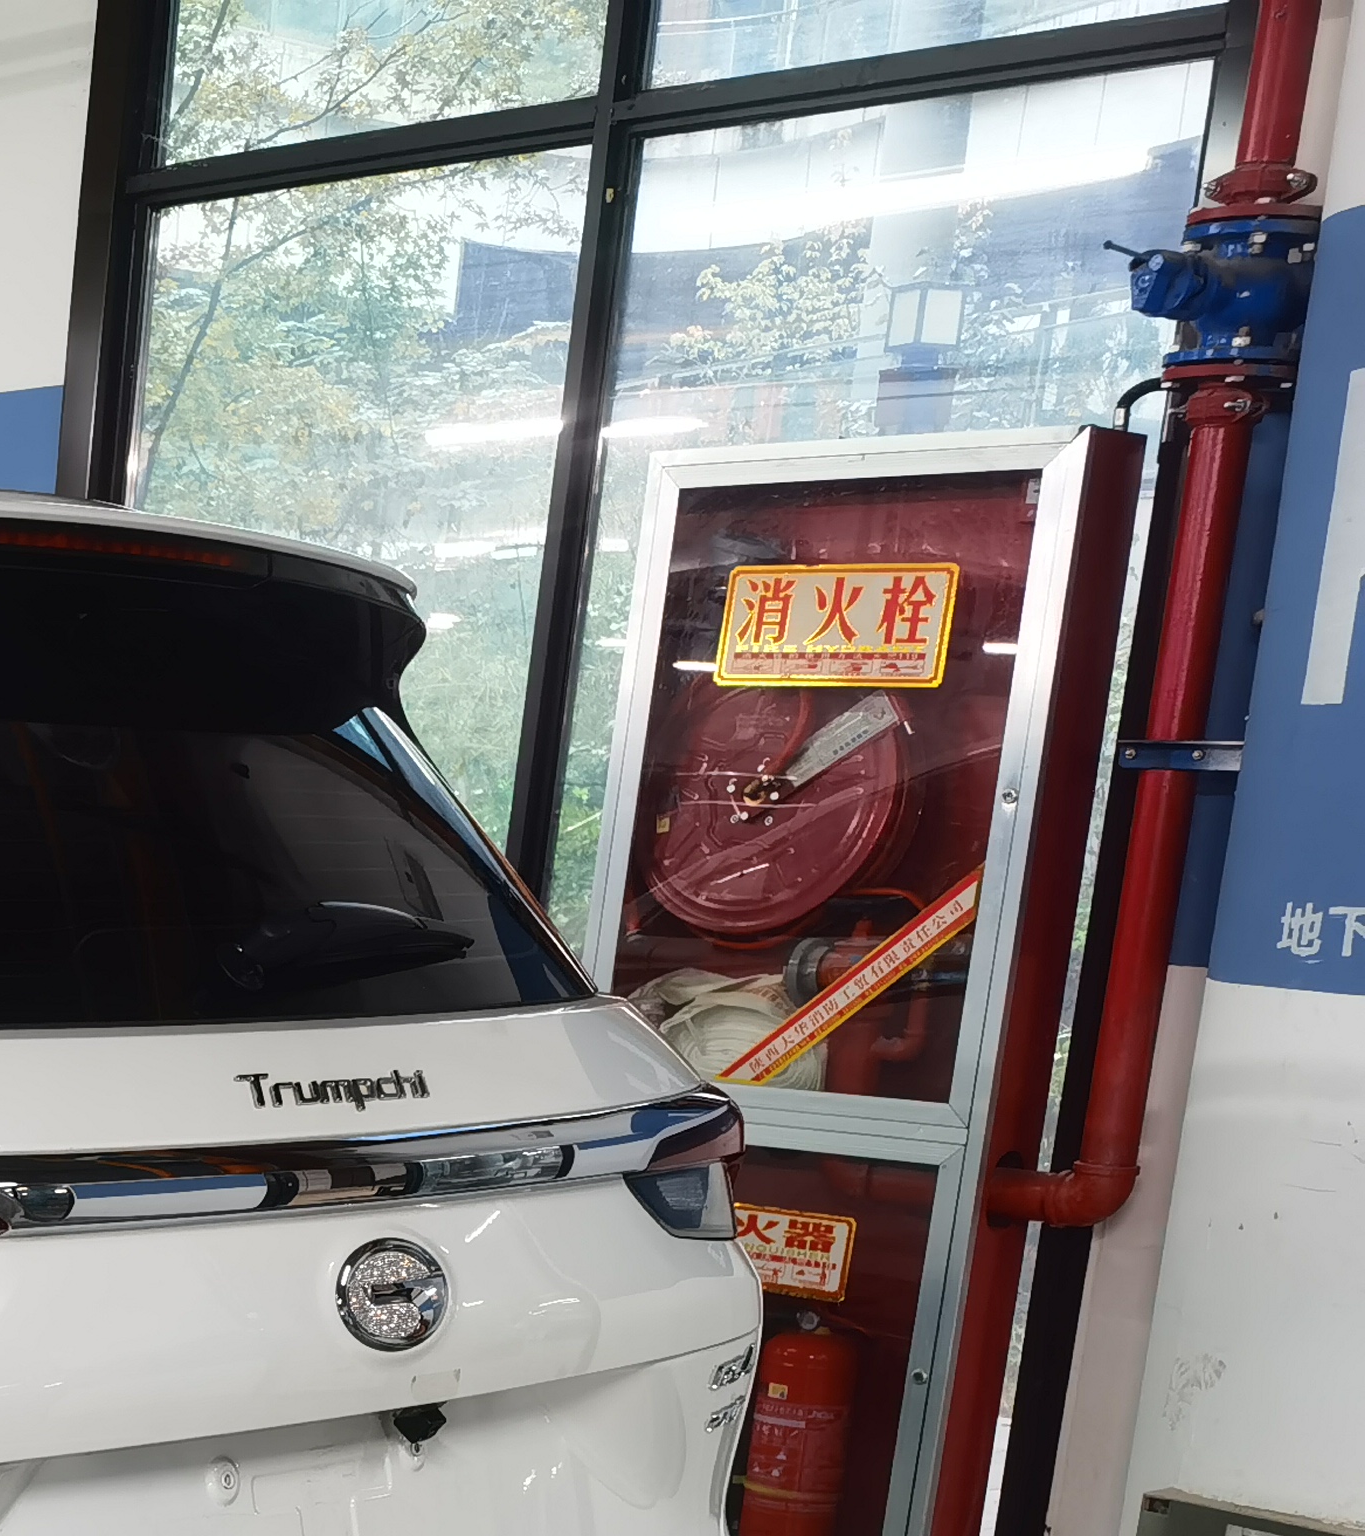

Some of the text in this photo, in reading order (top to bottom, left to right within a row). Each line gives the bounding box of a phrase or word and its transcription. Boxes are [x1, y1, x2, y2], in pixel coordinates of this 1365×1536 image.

[735, 576, 937, 645] 消火栓
[233, 1069, 431, 1112] Trumpchi
